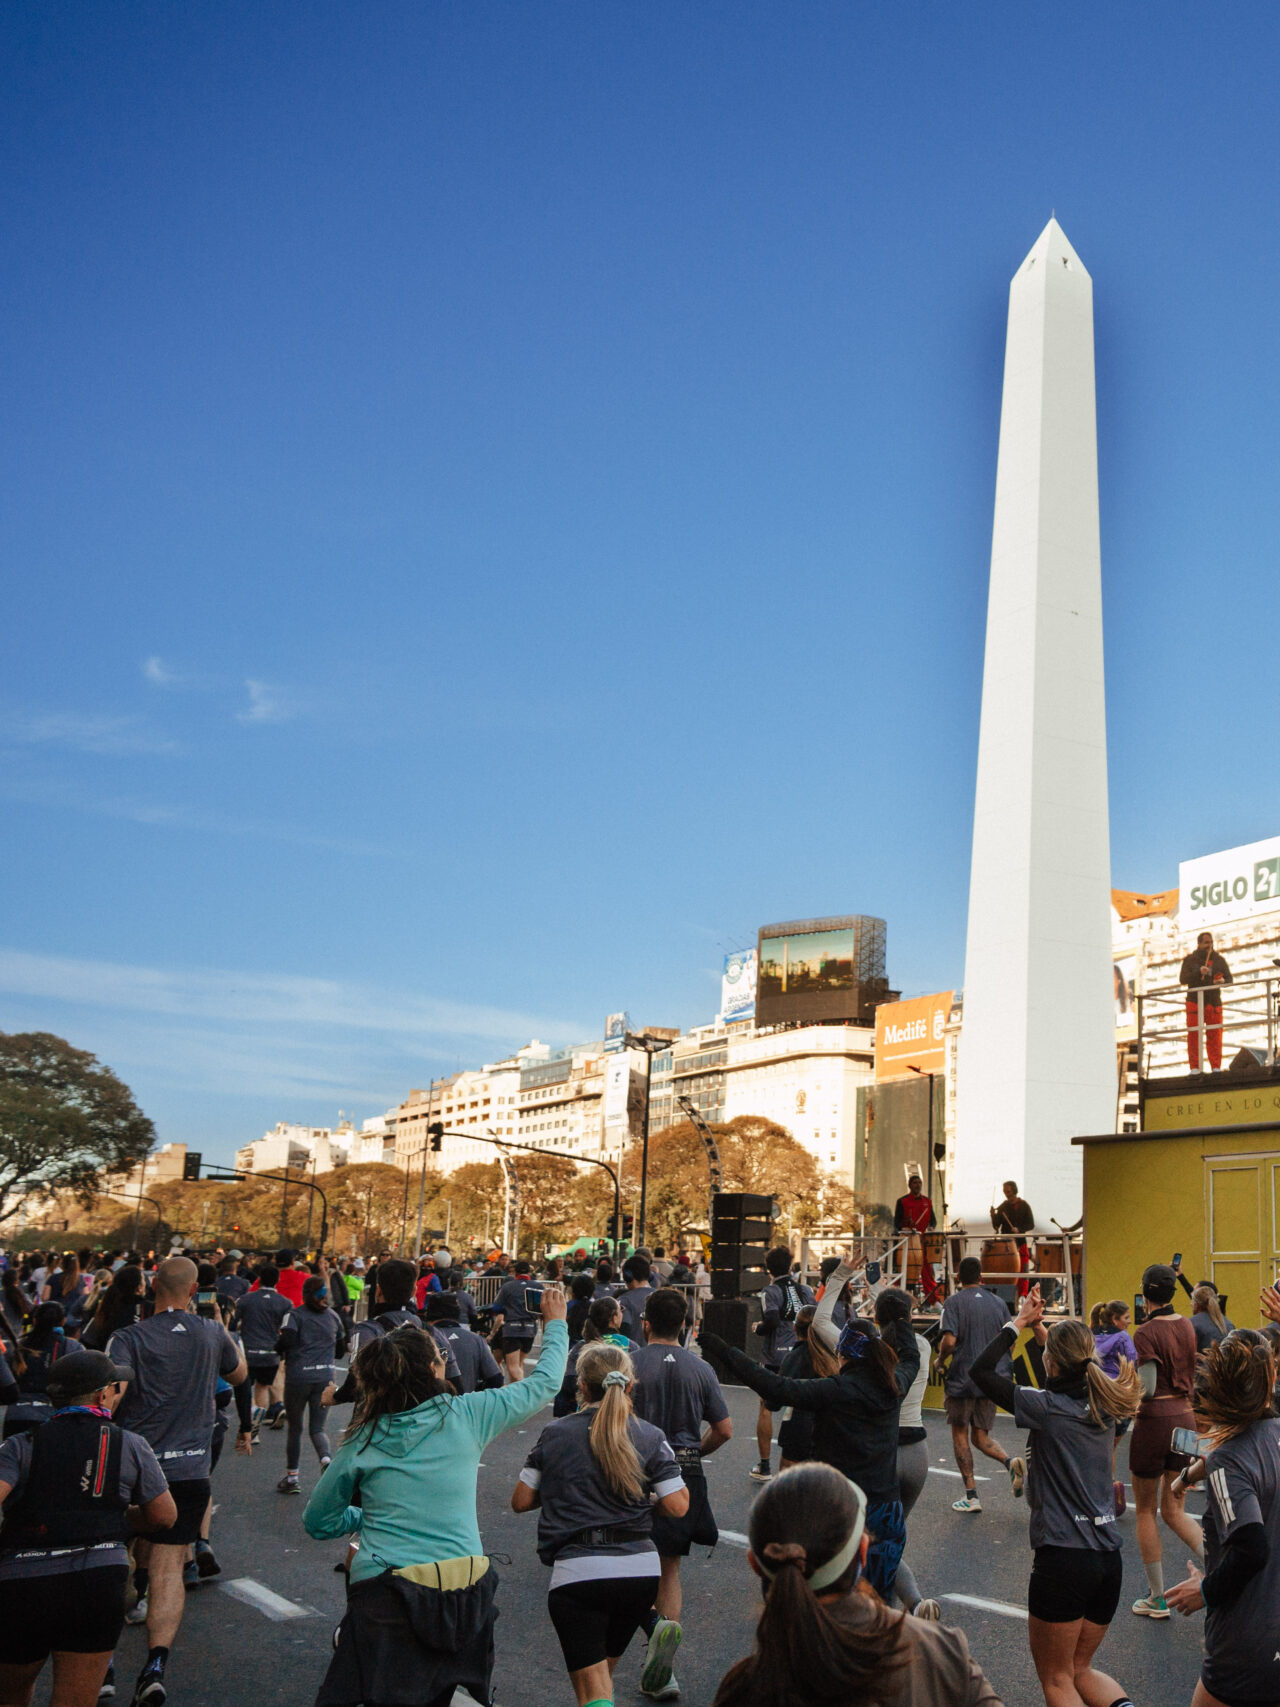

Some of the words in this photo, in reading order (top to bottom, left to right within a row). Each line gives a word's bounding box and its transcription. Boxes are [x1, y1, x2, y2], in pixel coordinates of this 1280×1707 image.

[1190, 876, 1248, 910] SIGLO
[1255, 865, 1279, 898] 21
[883, 1018, 927, 1045] Medifé
[1215, 1099, 1232, 1112] EN
[1244, 1098, 1262, 1110] LO
